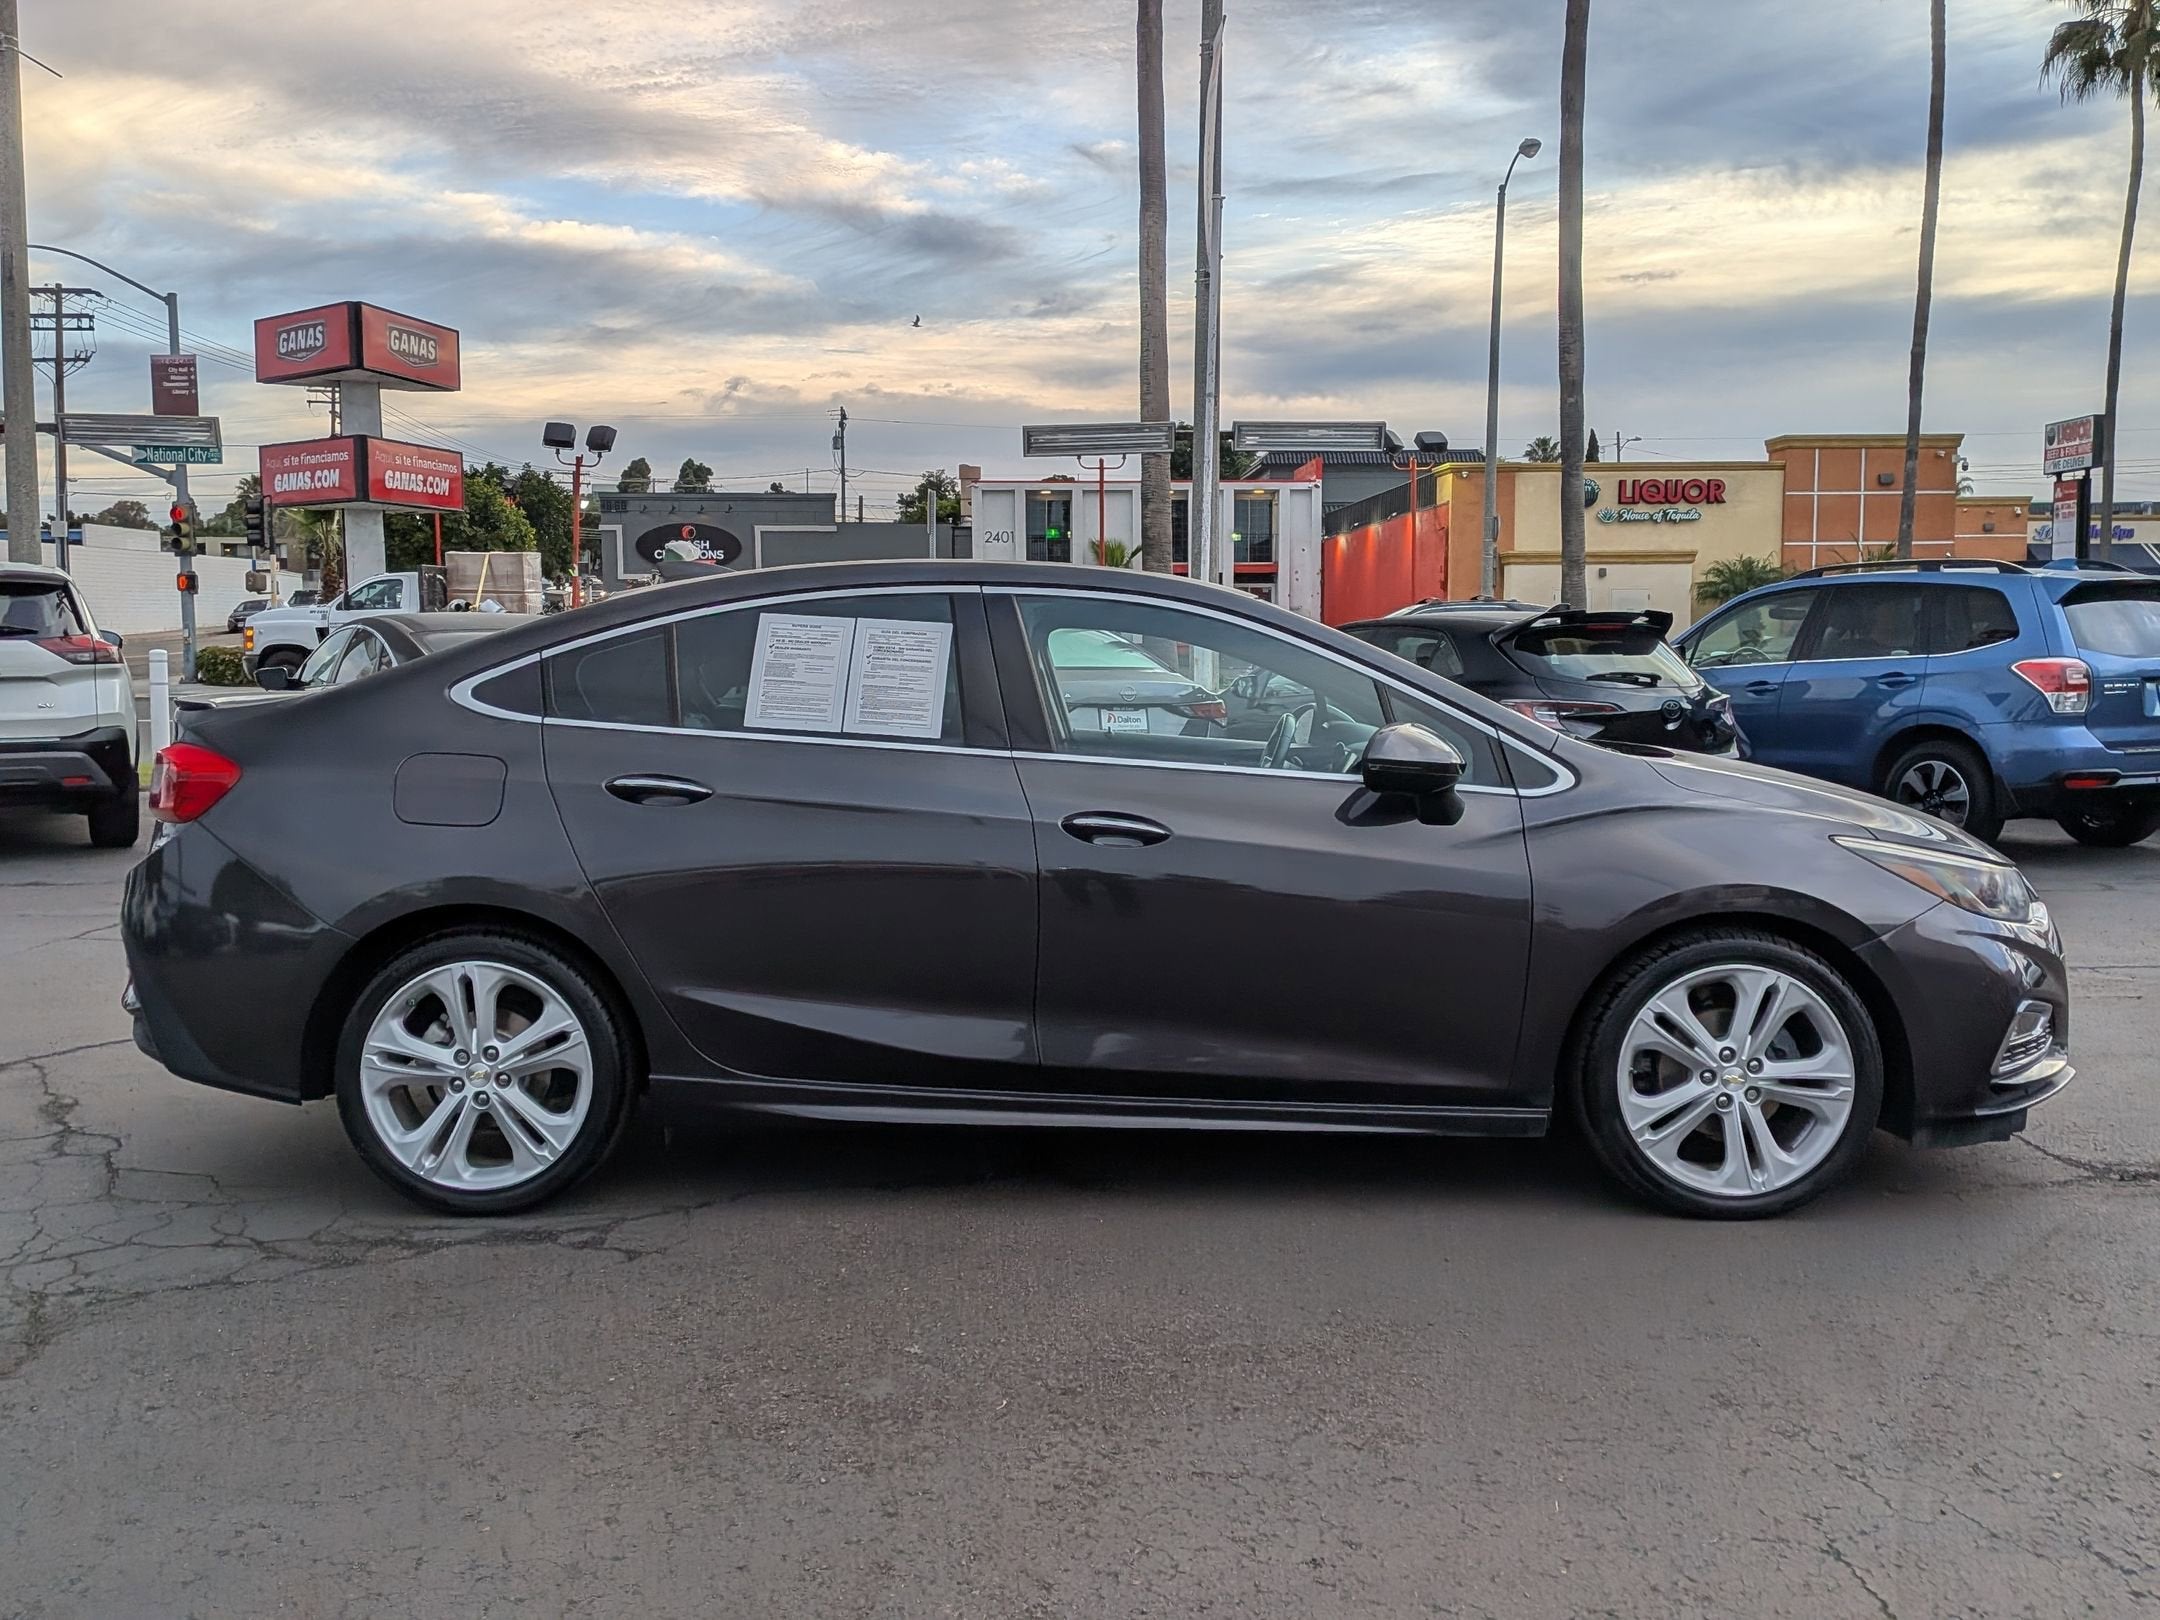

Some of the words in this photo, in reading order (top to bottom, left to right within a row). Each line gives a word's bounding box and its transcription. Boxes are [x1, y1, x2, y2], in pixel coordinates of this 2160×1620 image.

[279, 325, 323, 354] GANAS
[390, 330, 436, 360] GANAS
[146, 447, 186, 462] National
[188, 448, 207, 462] City
[292, 456, 300, 466] te
[300, 451, 349, 464] financiamos
[403, 454, 411, 465] te
[412, 456, 458, 474] financiamos
[2062, 456, 2085, 469] DELIVER
[274, 468, 340, 492] GANAS.COM
[384, 470, 450, 496] GANAS.COM
[1618, 478, 1726, 505] LIQUOR
[1618, 508, 1650, 522] House
[1652, 508, 1664, 523] of
[1665, 508, 1701, 524] Tequila
[984, 530, 1014, 544] 2401
